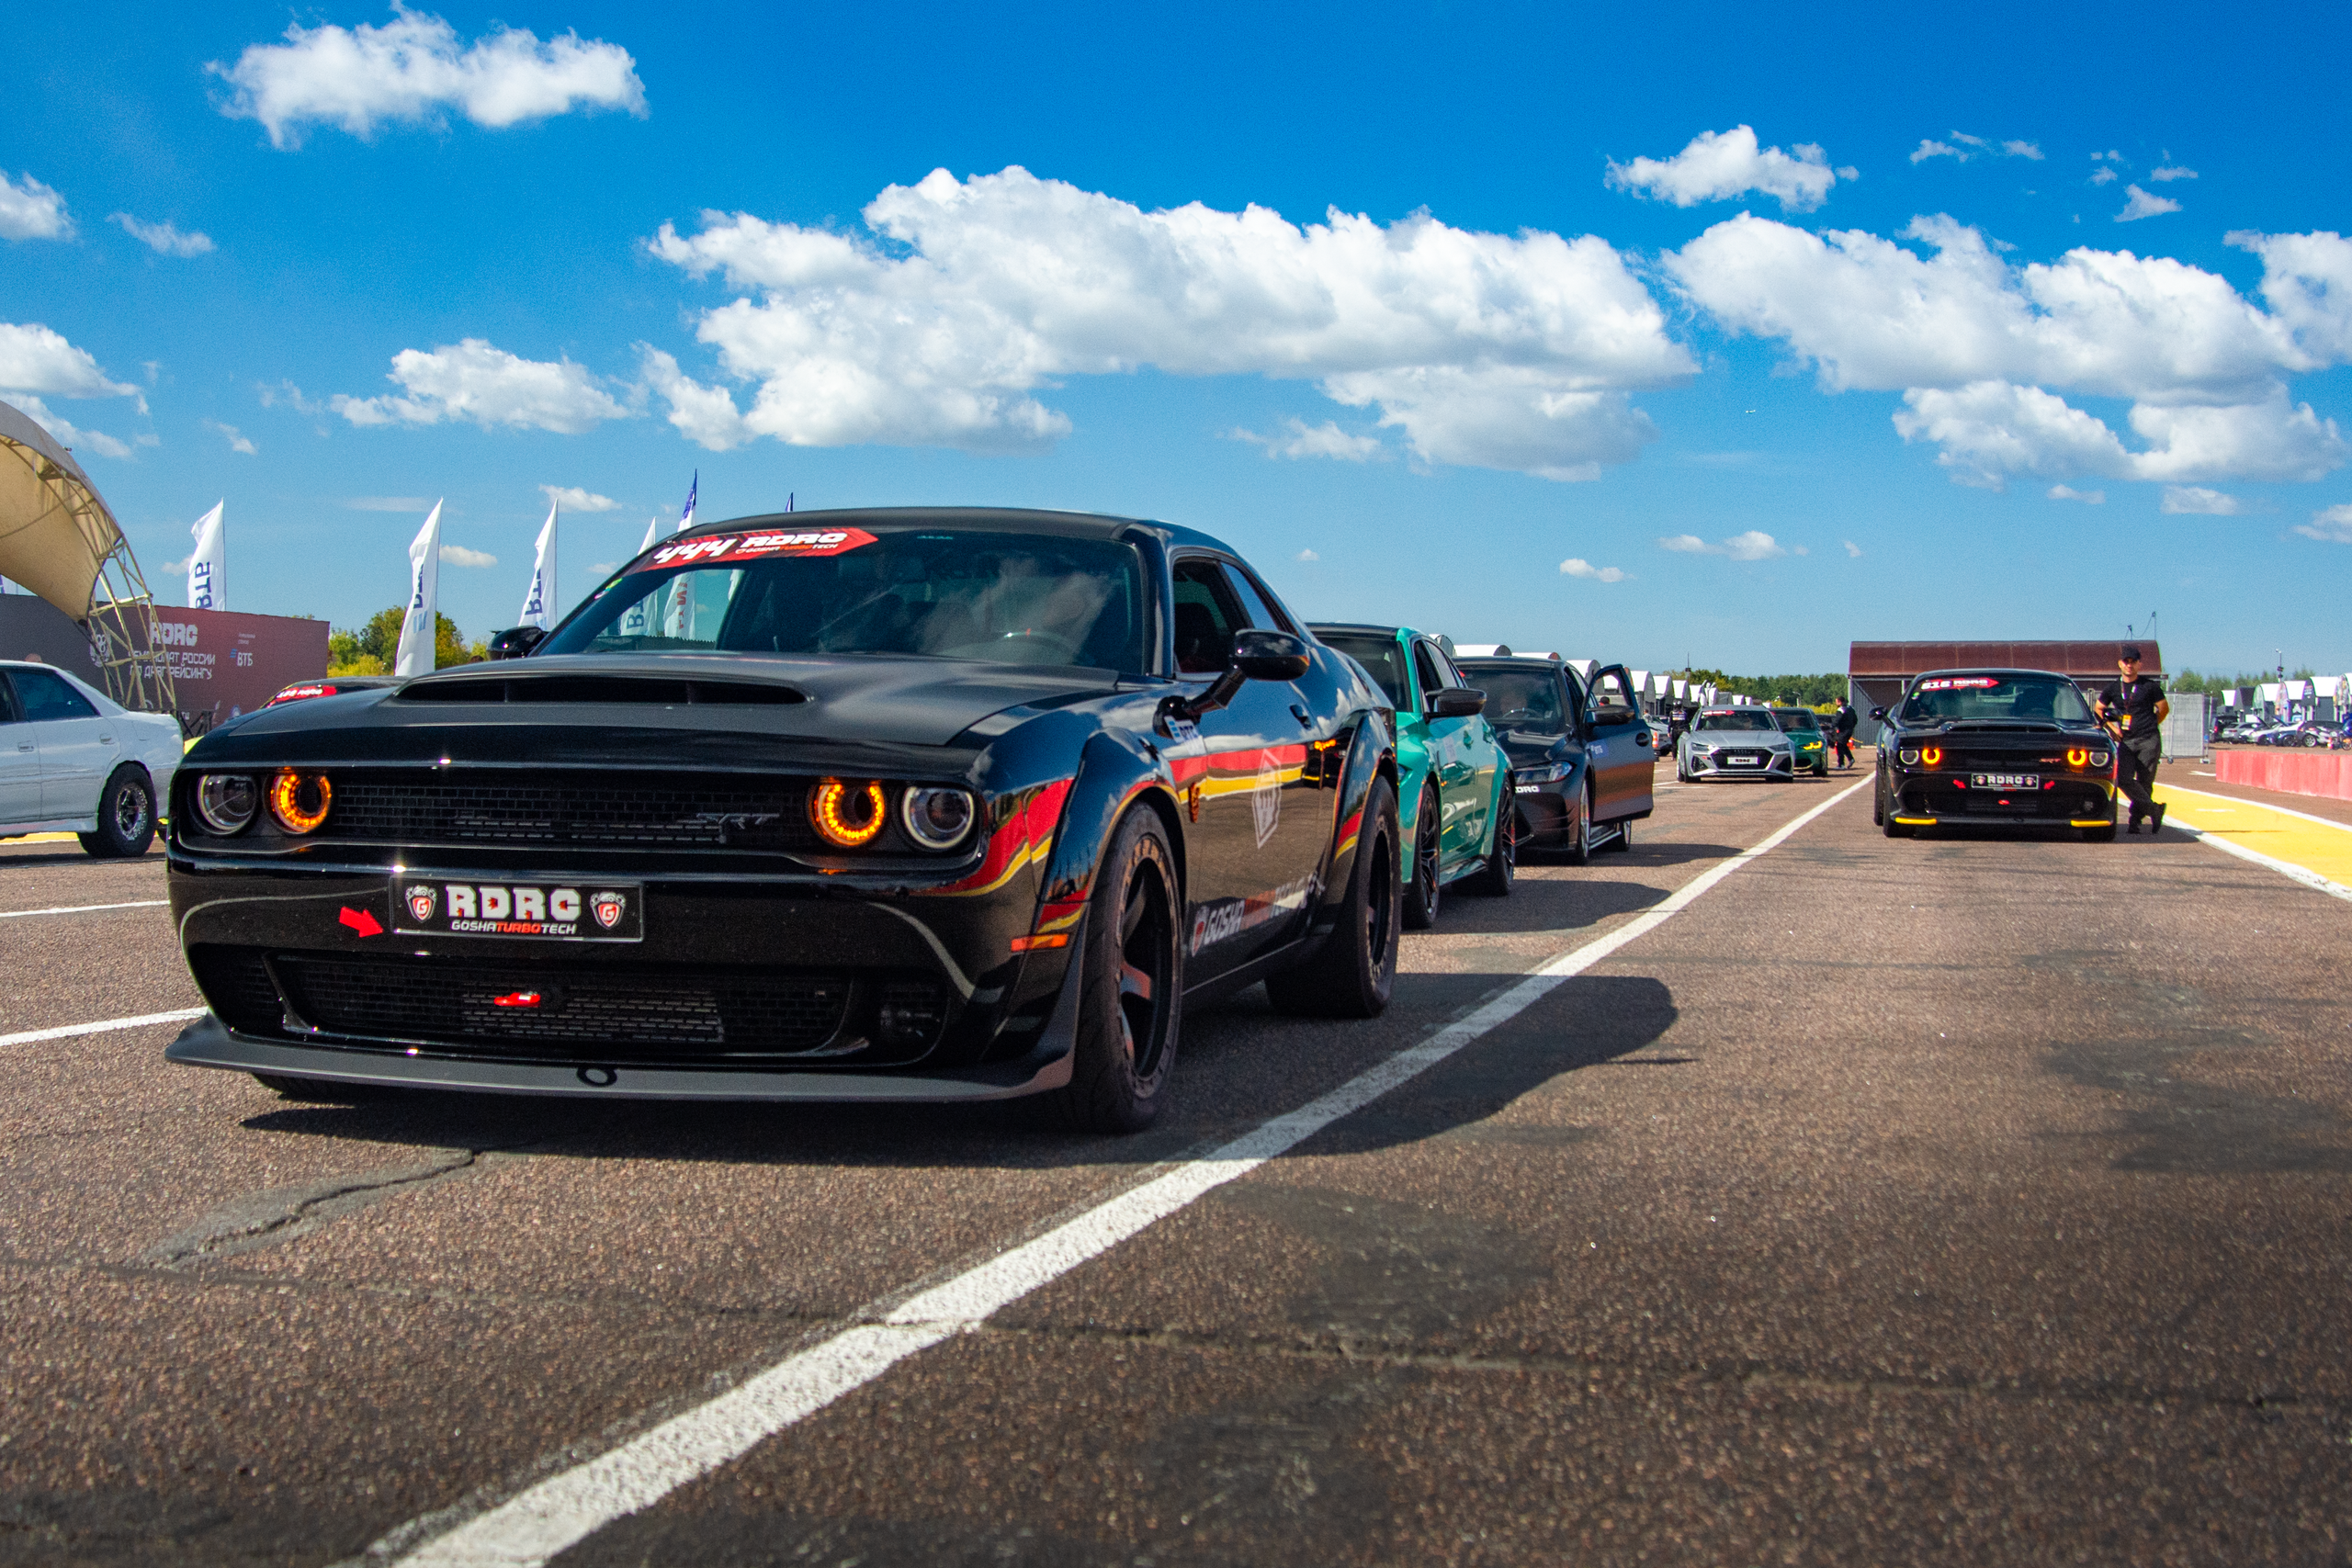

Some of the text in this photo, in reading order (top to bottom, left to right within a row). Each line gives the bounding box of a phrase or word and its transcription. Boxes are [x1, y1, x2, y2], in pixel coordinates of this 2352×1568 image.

[653, 532, 848, 564] 444 RDRC
[150, 622, 198, 646] RDRC
[182, 651, 216, 665] РОССИИ
[237, 652, 254, 667] ВТБ
[1987, 775, 2023, 784] RDRC
[1515, 785, 1540, 794] DRC
[446, 885, 582, 921] RDRC
[451, 919, 577, 934] GOSHATURBOTECH
